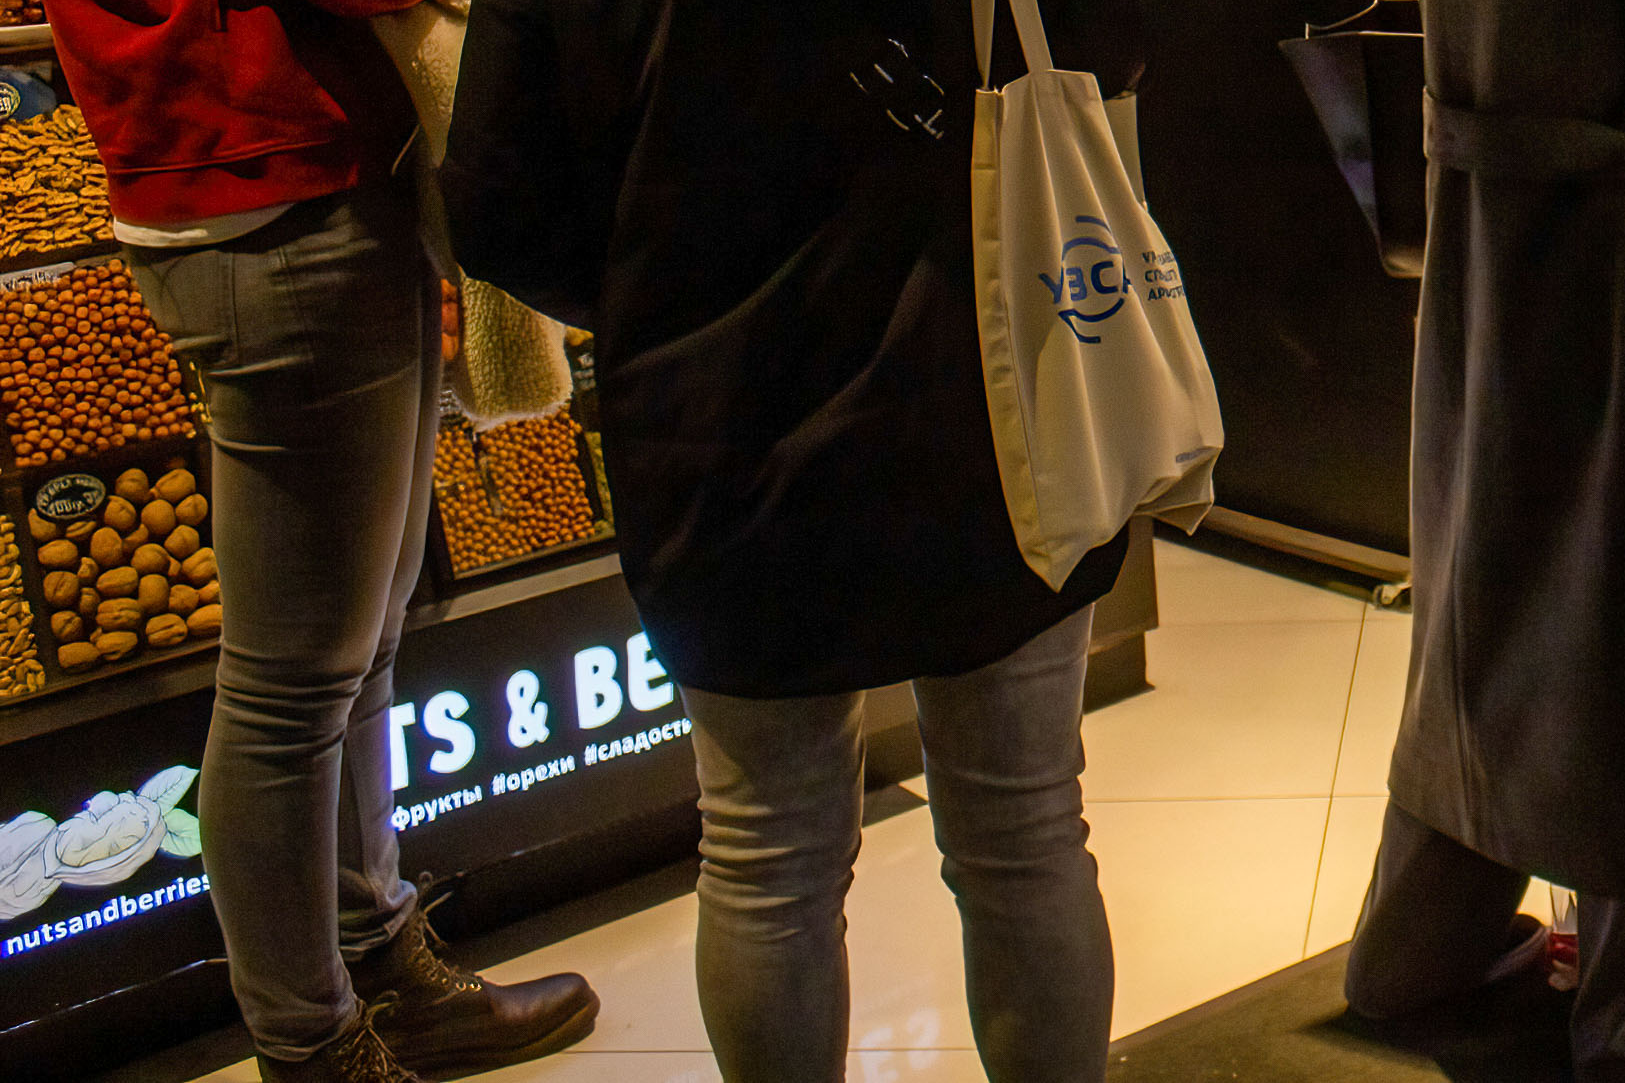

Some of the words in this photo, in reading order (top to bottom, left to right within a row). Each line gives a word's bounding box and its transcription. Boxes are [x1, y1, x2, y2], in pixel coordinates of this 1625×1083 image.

[506, 669, 549, 748] &
[491, 755, 576, 796] #орехи
[7, 874, 210, 955] nutsandberries
